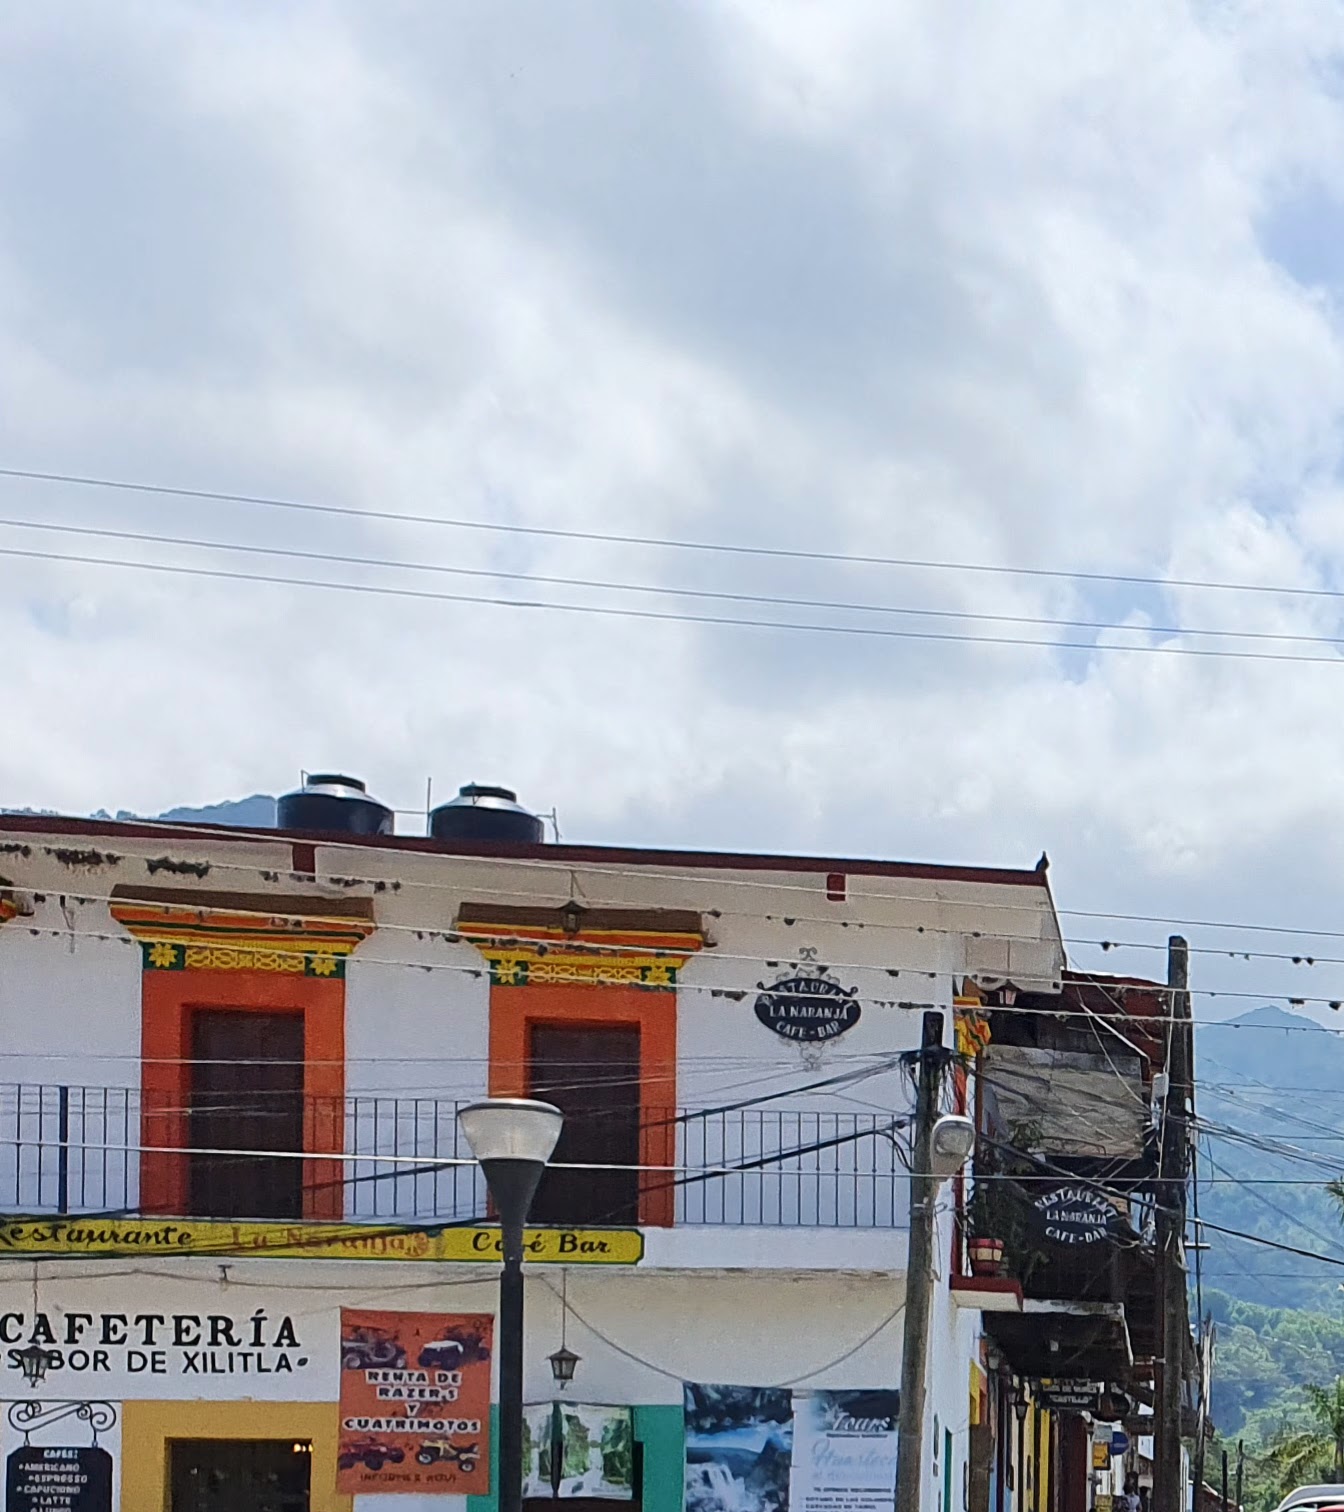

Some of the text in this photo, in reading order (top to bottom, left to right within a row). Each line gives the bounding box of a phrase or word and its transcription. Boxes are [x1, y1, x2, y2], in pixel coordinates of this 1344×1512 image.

[769, 1005, 848, 1019] LA NARANJA
[473, 1231, 547, 1253] Caé
[559, 1233, 611, 1253] Bar
[0, 1308, 301, 1348] CAFETERÍA
[7, 1349, 293, 1374] SBOR DE XILITLA
[367, 1370, 461, 1385] RENTA DE
[343, 1418, 480, 1433] CUATRIMOTOS
[40, 1496, 71, 1506] LATTE
